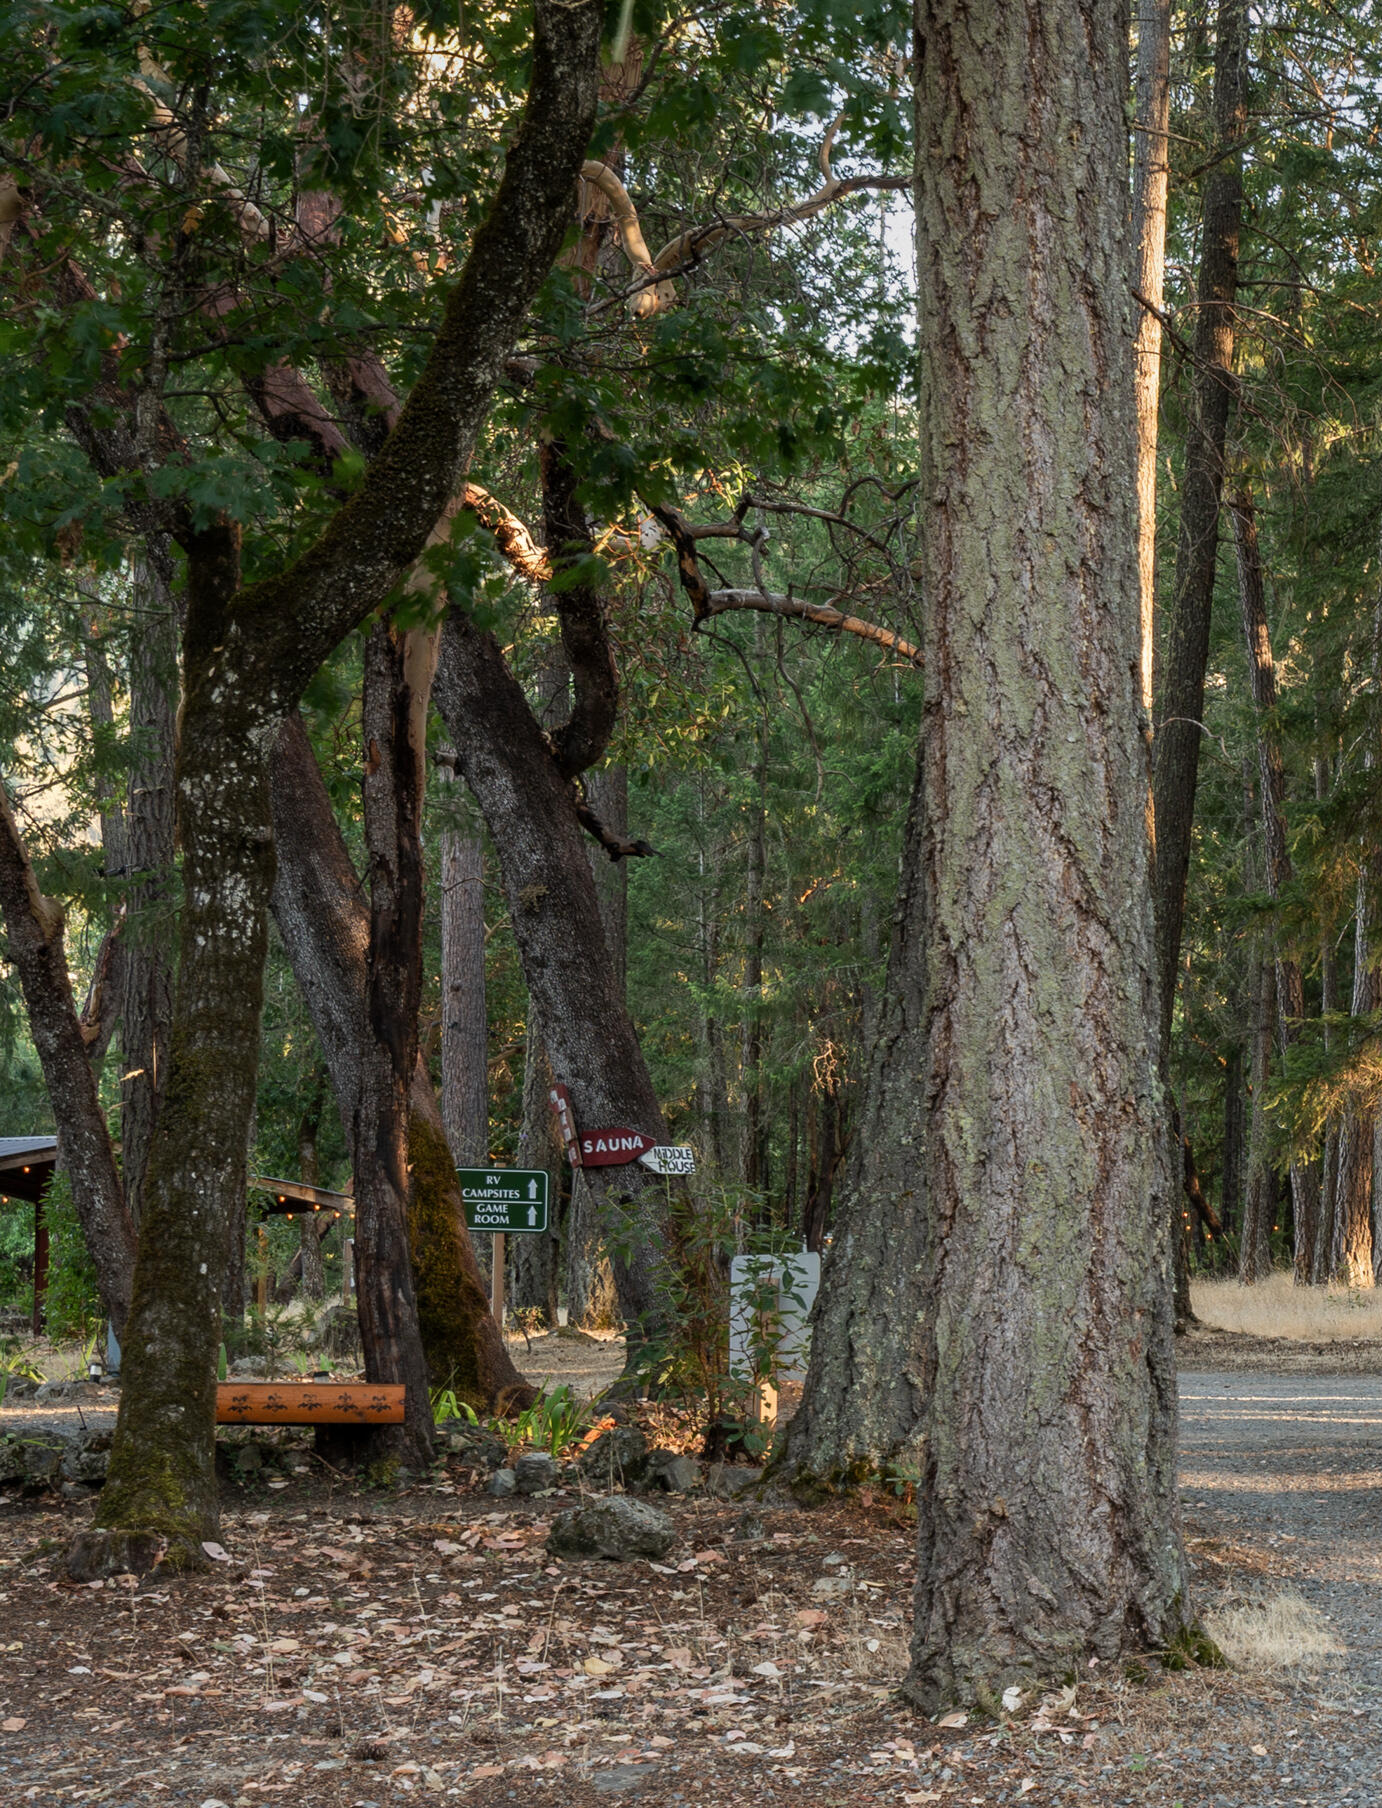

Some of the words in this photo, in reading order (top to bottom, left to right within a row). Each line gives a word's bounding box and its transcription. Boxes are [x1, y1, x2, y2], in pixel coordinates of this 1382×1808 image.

[583, 1135, 644, 1154] SAUNA
[658, 1160, 697, 1174] HOUSE
[486, 1175, 501, 1185] RV
[462, 1188, 520, 1199] CAMPSITES
[476, 1204, 508, 1213] GAME
[474, 1214, 510, 1224] ROOM
